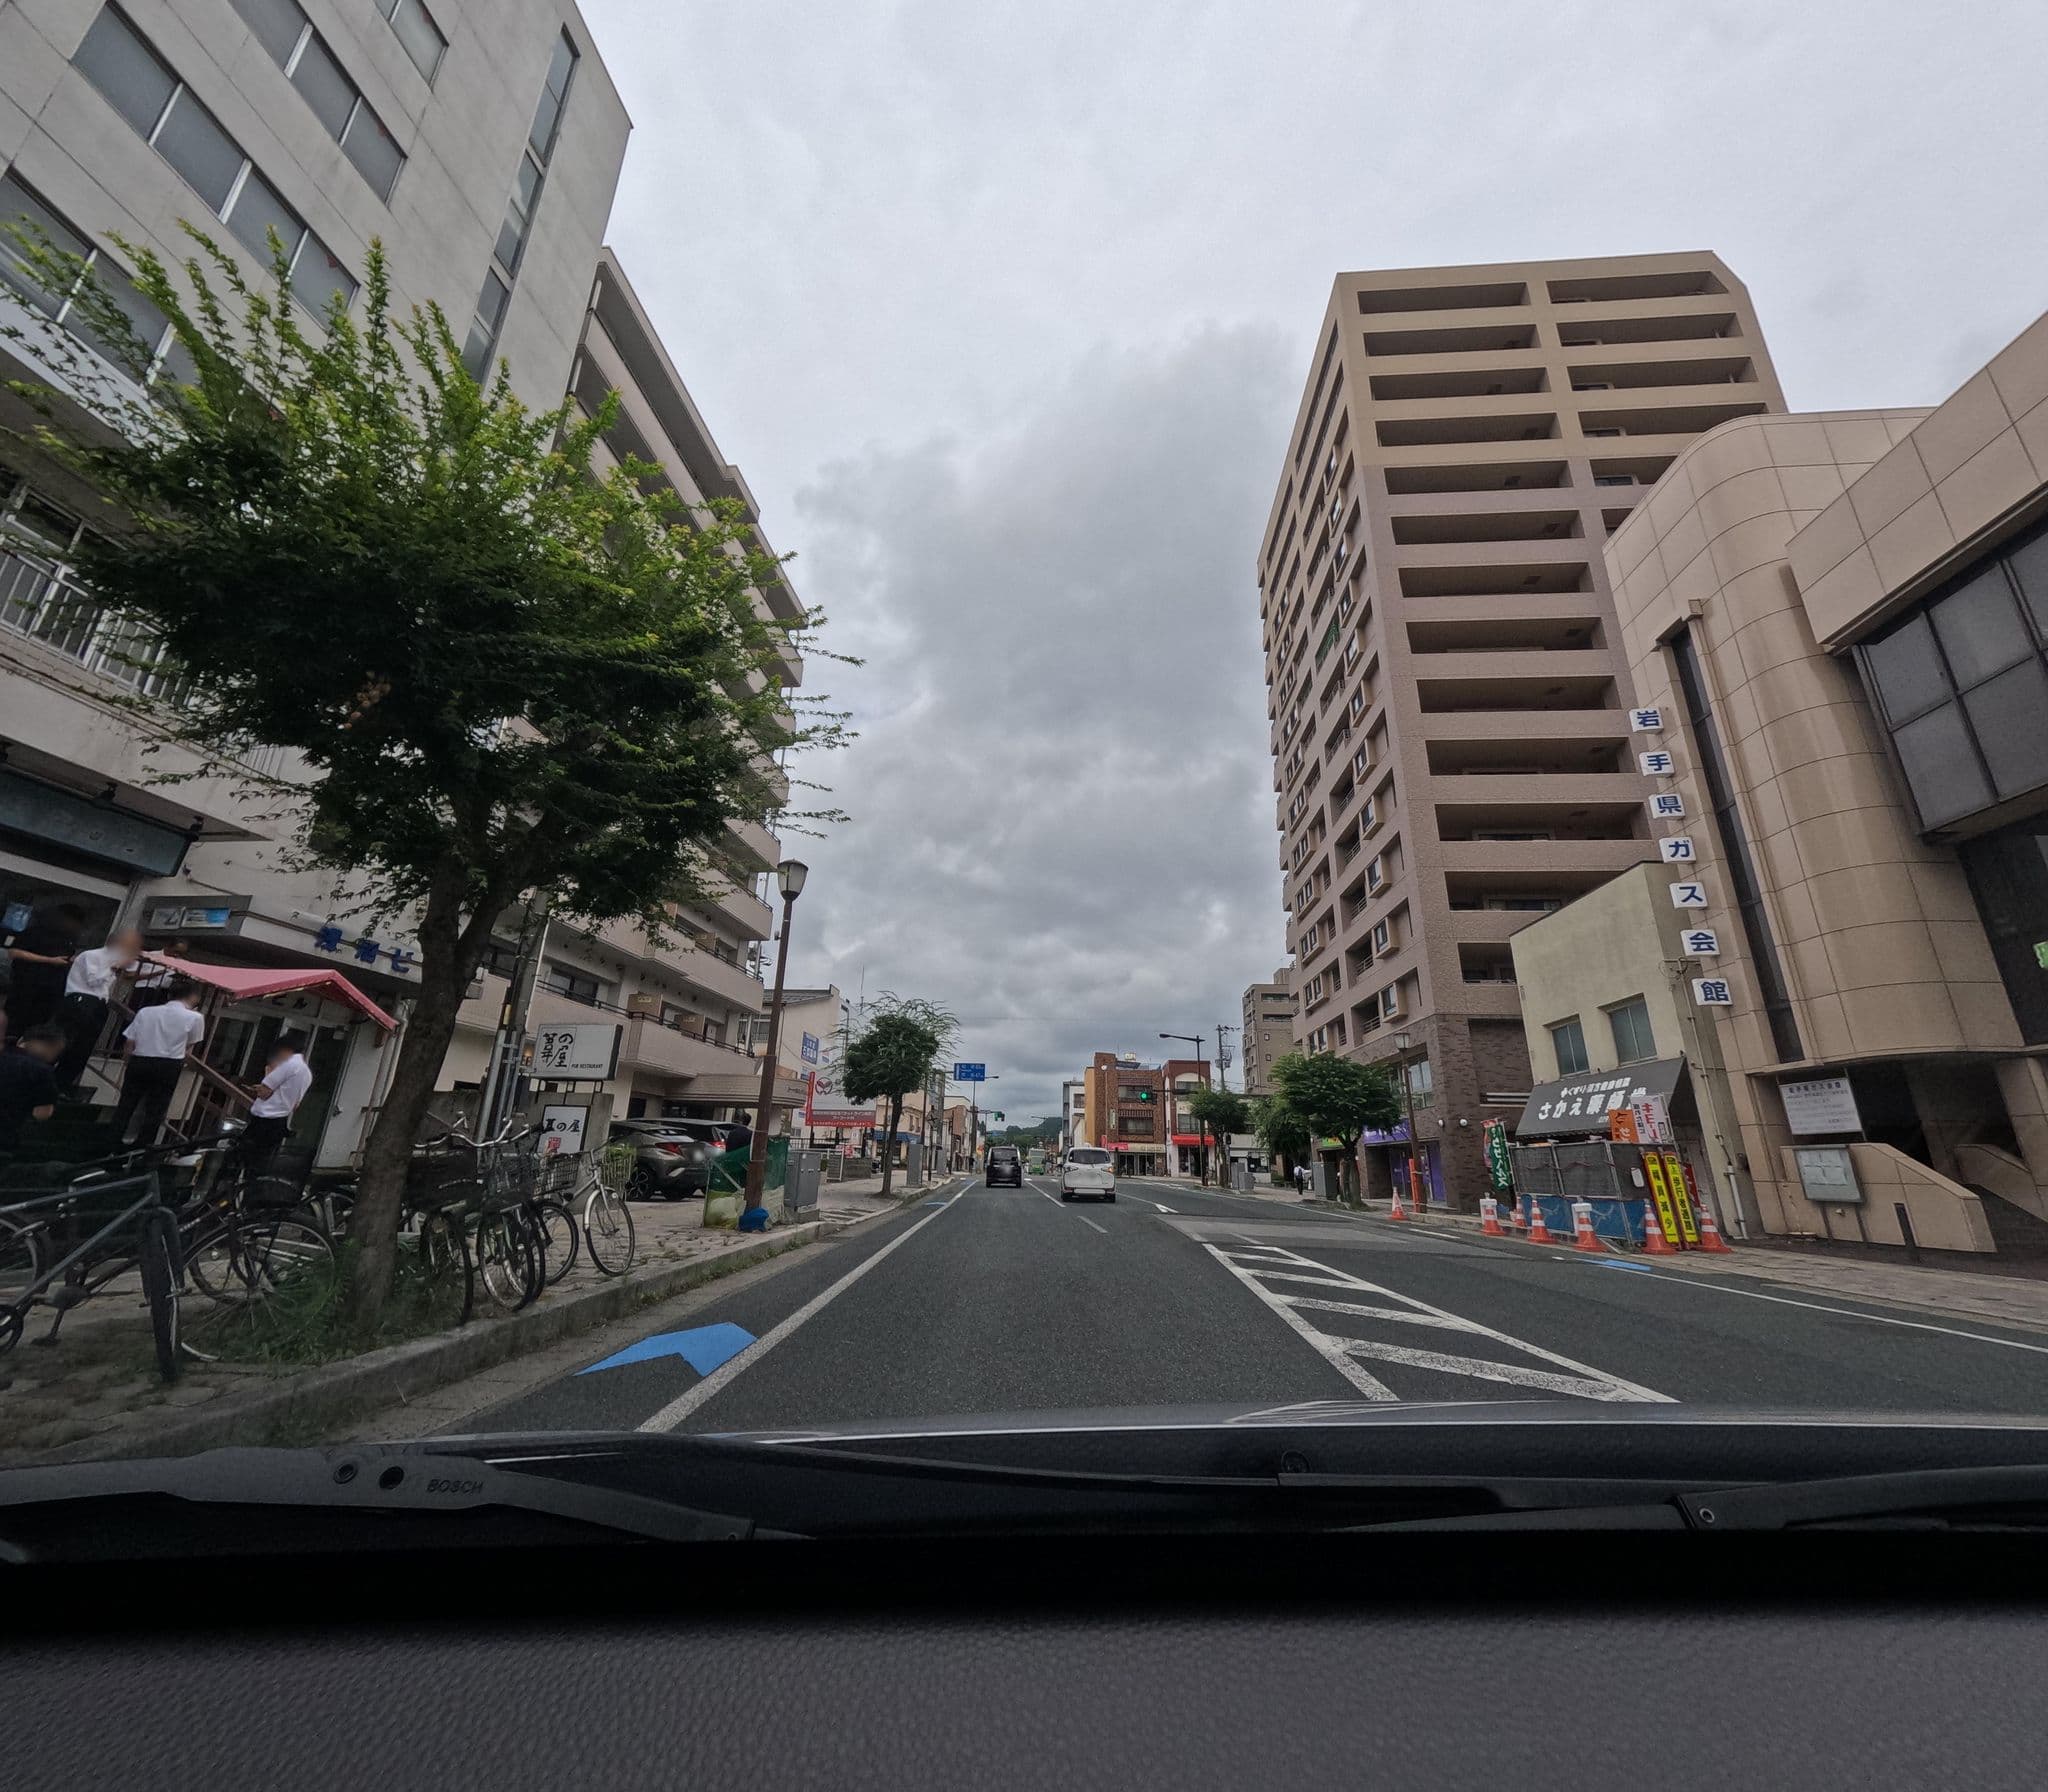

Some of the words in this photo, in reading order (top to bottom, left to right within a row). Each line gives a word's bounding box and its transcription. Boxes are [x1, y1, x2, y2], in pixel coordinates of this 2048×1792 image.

[1636, 709, 1730, 1004] 岩手県ガス会館
[426, 1479, 485, 1495] BOSCH
